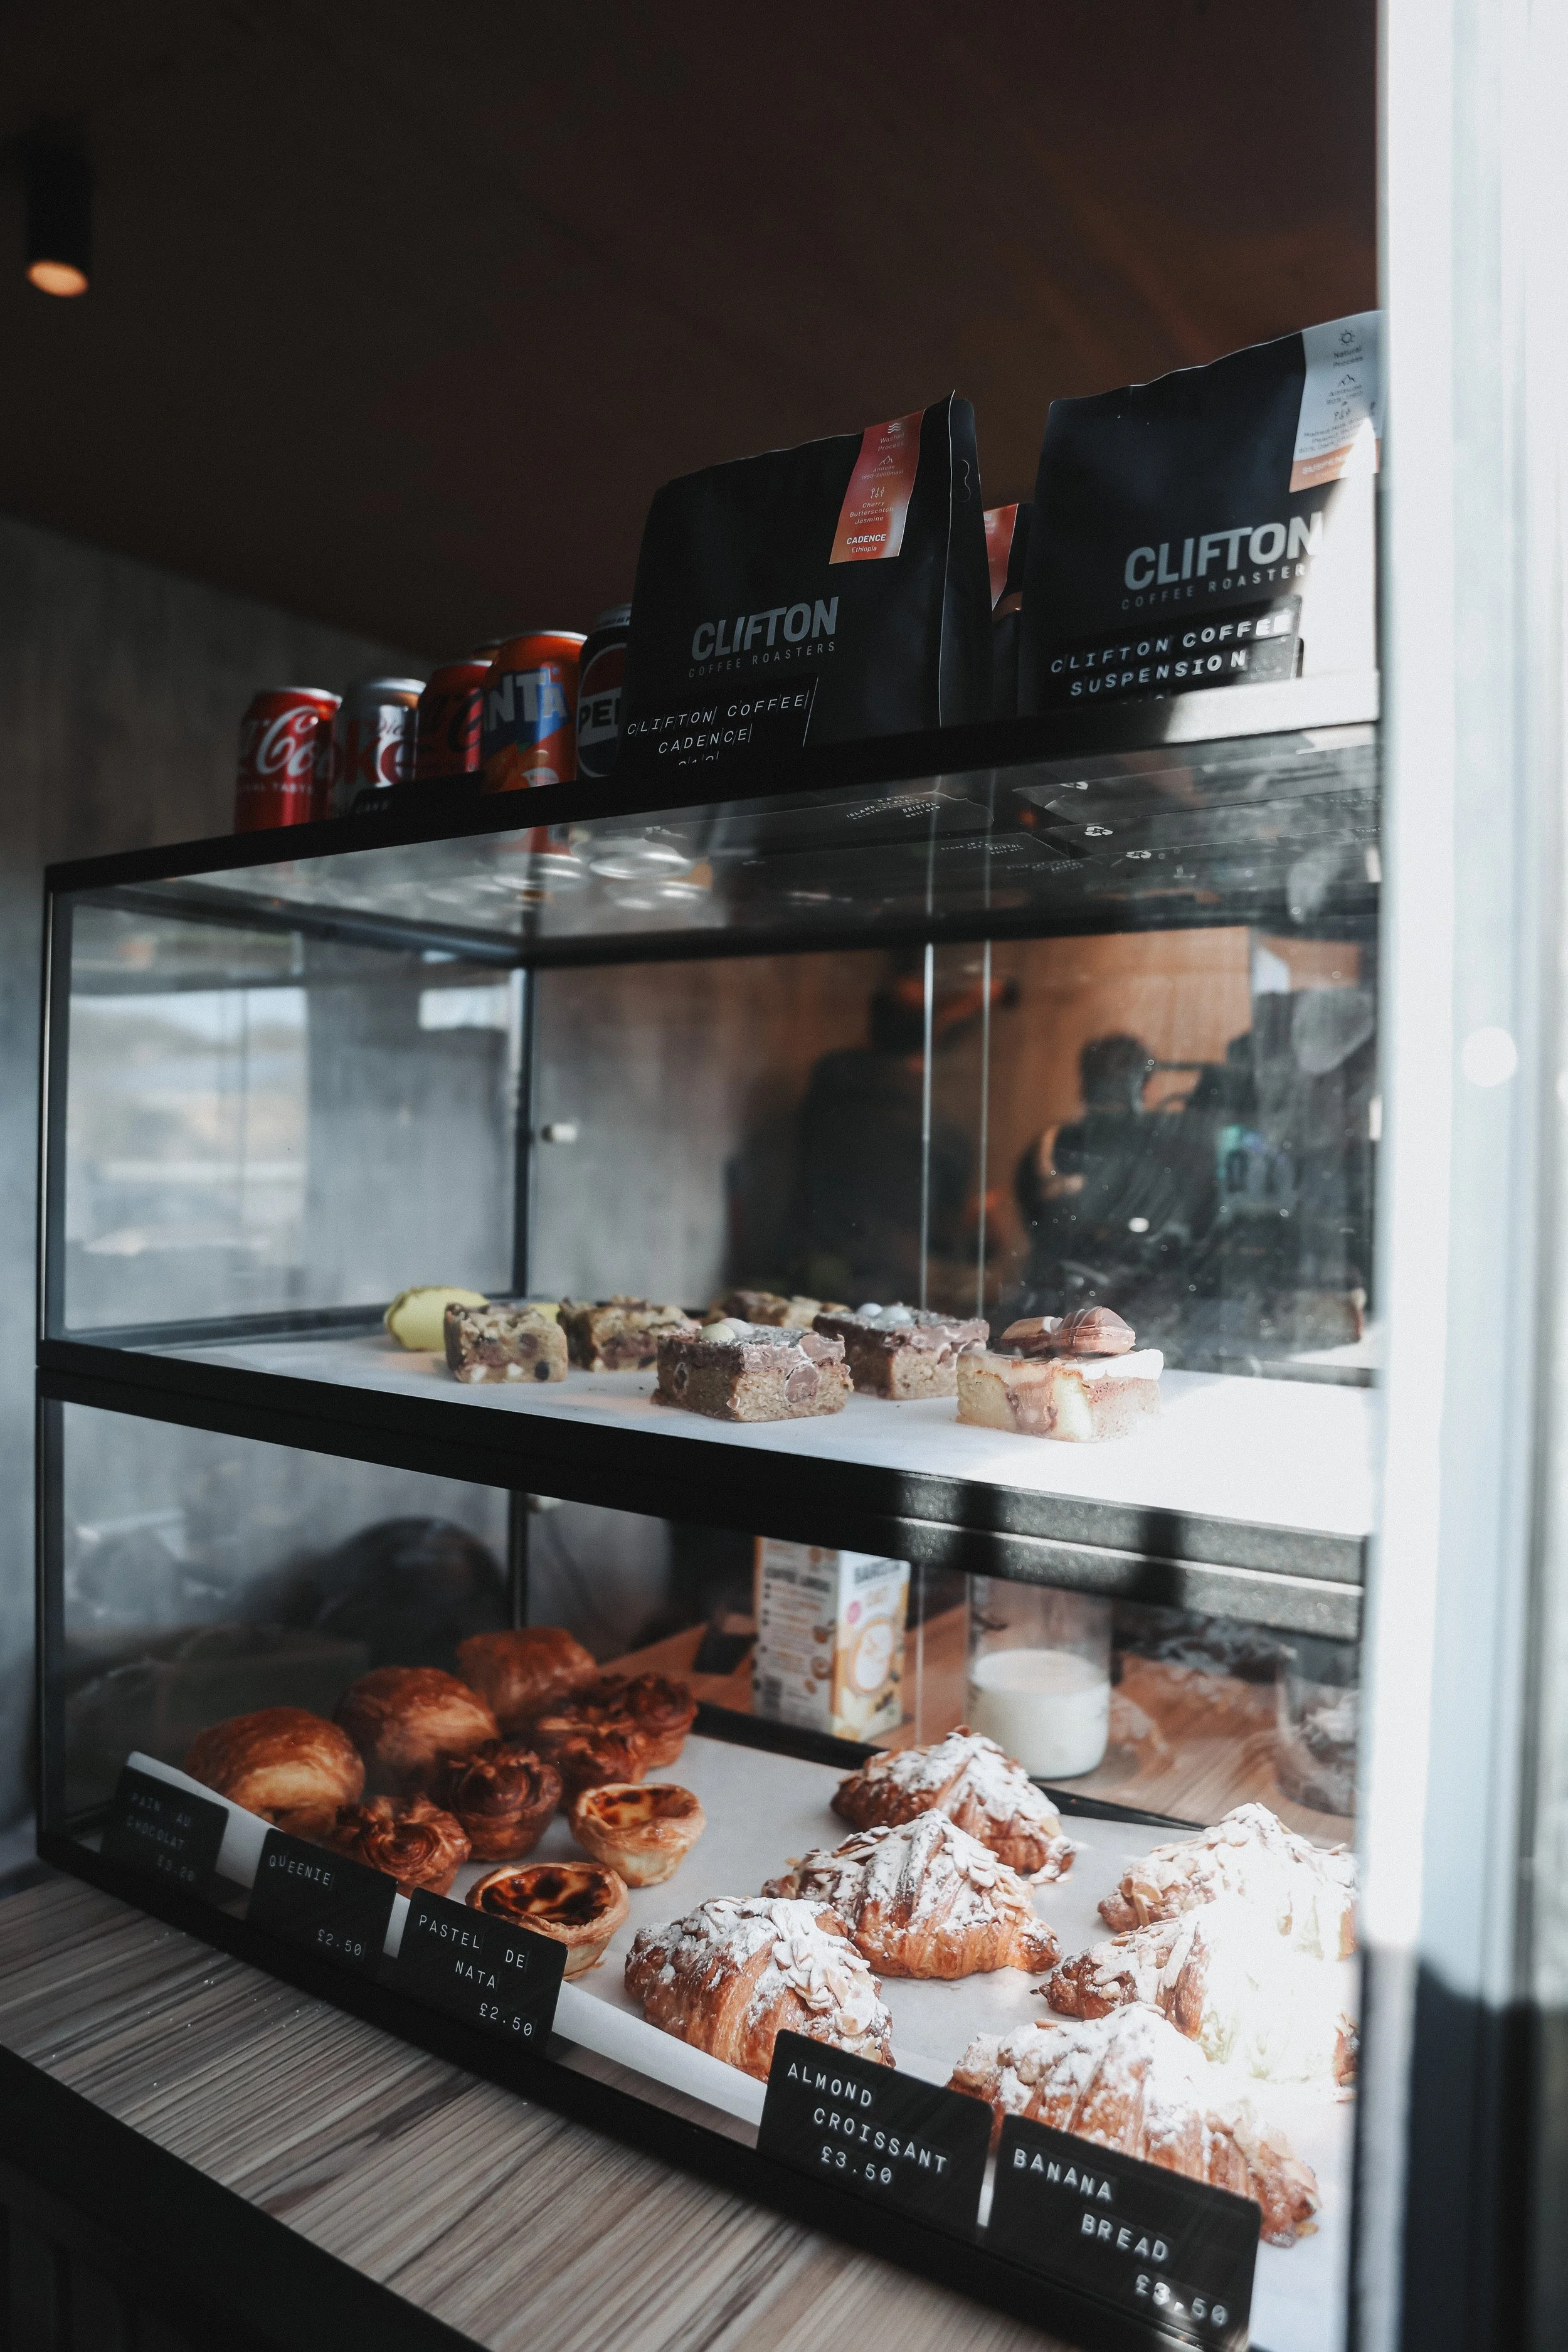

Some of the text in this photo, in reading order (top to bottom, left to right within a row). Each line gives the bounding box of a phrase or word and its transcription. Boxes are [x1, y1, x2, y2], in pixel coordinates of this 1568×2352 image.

[878, 442, 904, 452] Process
[880, 432, 904, 443] Washed
[872, 465, 895, 473] Altitude
[849, 507, 894, 517] Butterscotch
[855, 516, 884, 524] Jasmine
[846, 534, 887, 544] CADENCE
[851, 545, 877, 553] Ethiopia
[1124, 511, 1322, 590] CLIFTON
[1121, 563, 1306, 611] COFFEE ROASTER
[691, 596, 839, 661] CLIFTON
[1051, 615, 1291, 674] CLIFTON COFFE
[689, 641, 835, 679] COFFEE ROASTERS
[1070, 649, 1246, 696] SUSPENSION
[627, 694, 805, 735] CLIFTON COFFEE
[659, 728, 748, 753] CADENCE
[903, 802, 936, 813] BRISTOL
[268, 1855, 331, 1886] QUEENIE
[316, 1928, 363, 1956] £2.50
[419, 1914, 526, 1969] PASTEL DE
[455, 1959, 497, 1989] NATA
[479, 2003, 532, 2037] £2.50
[788, 2063, 873, 2107] ALMOND
[813, 2107, 948, 2175] CROISSANT
[821, 2145, 893, 2185] £3.50
[1014, 2148, 1113, 2202] BANANA
[1081, 2213, 1170, 2262] BREAD
